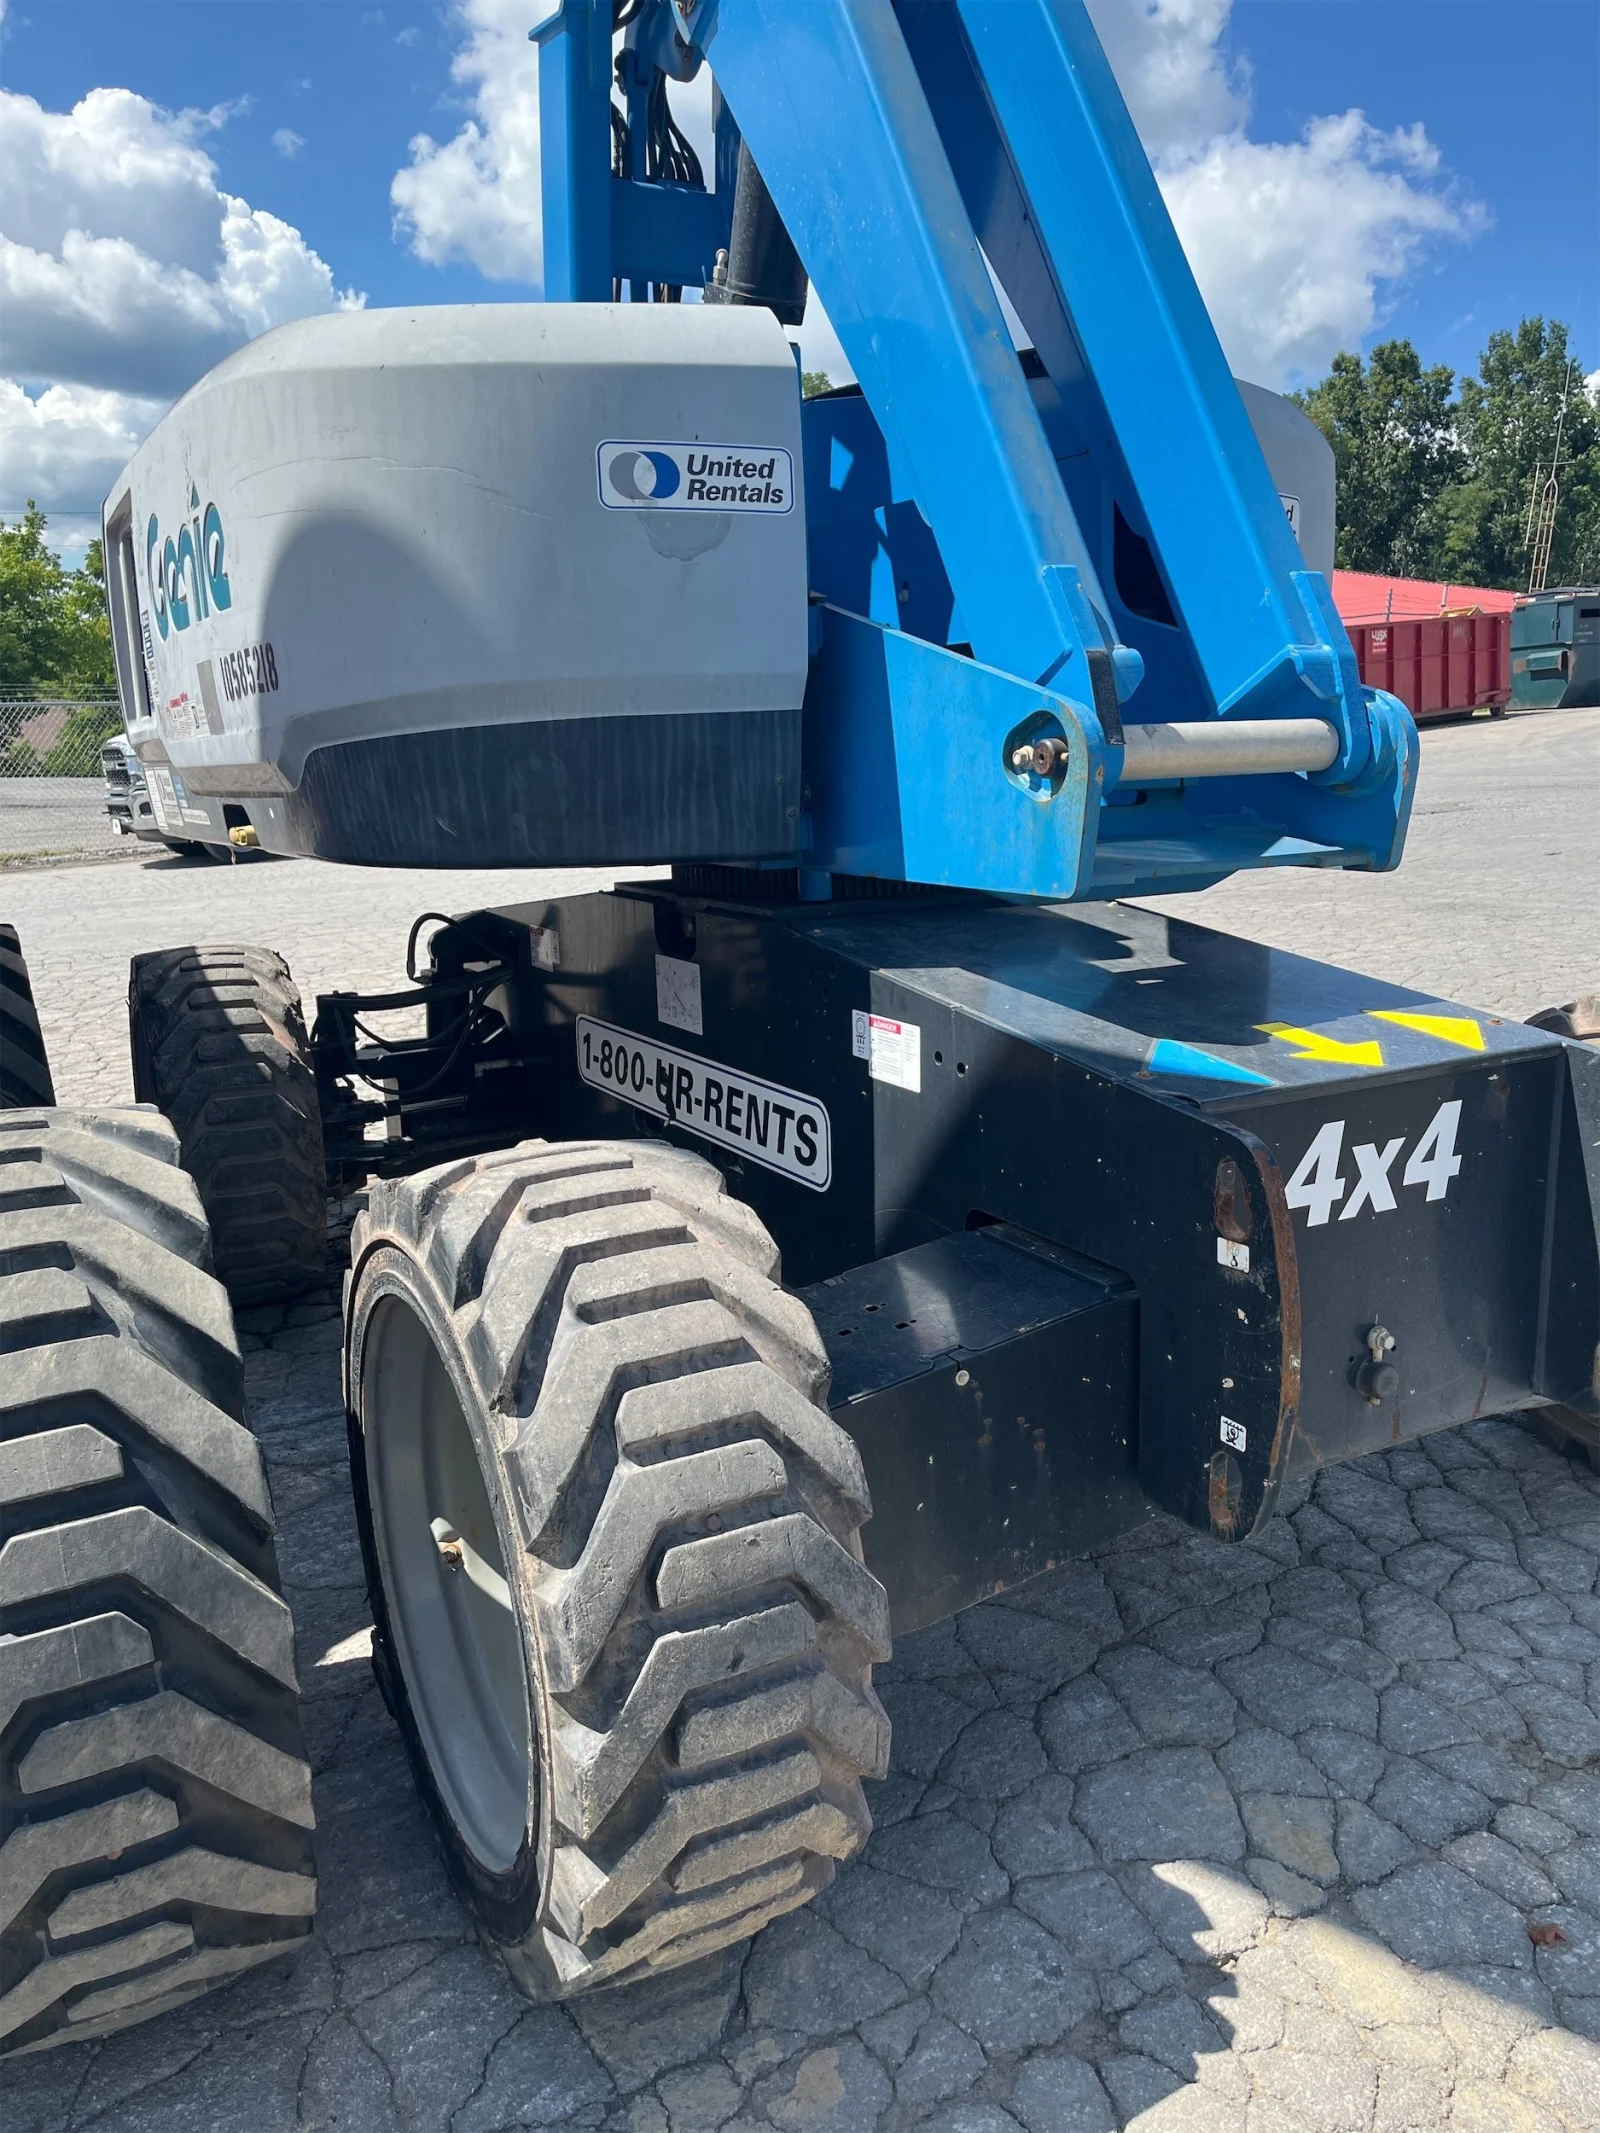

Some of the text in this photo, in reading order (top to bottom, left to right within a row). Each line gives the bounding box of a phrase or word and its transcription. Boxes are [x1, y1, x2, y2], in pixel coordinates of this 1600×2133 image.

[687, 454, 775, 478] United
[687, 479, 784, 504] Rentals
[147, 480, 232, 641] Genie
[219, 642, 279, 702] 10585218
[583, 1032, 818, 1167] 1-800-UR-RENTS
[1284, 1100, 1463, 1227] 4x4
